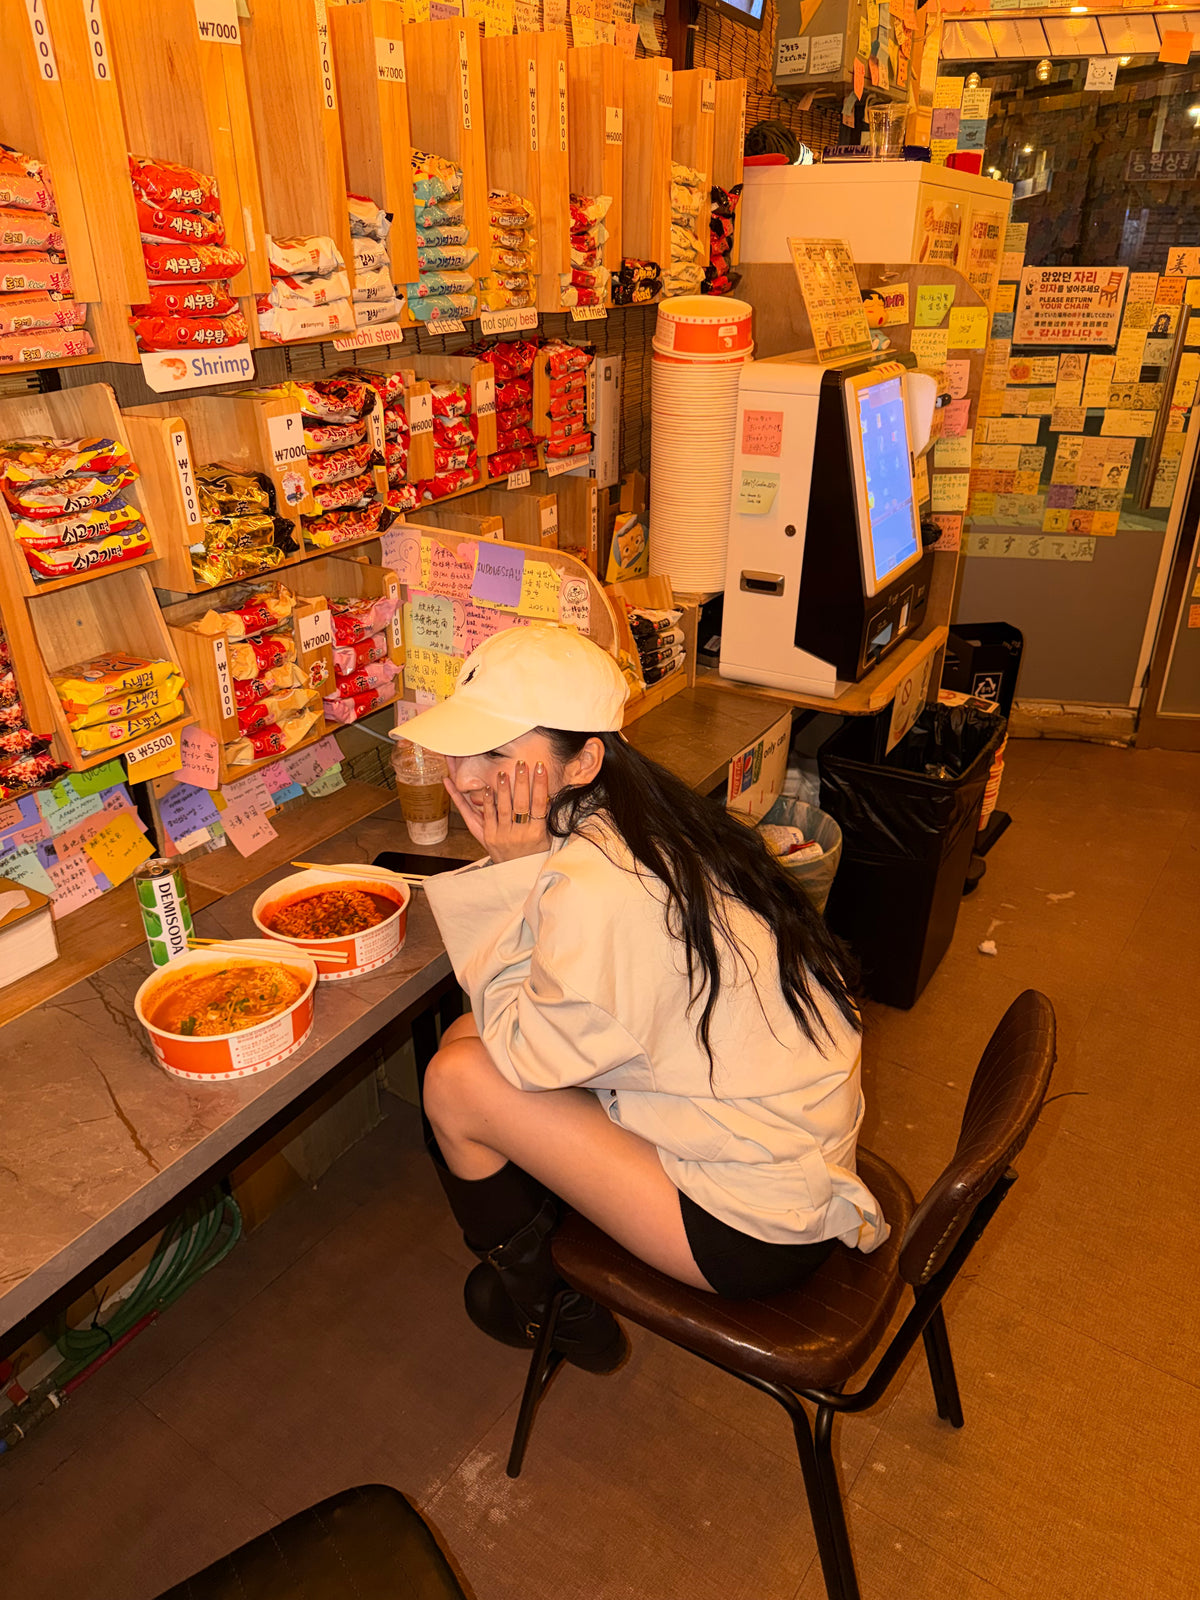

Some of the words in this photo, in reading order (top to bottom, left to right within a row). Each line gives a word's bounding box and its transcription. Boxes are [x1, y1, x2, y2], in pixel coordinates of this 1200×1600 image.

[199, 22, 238, 40] ₩7000
[389, 43, 395, 54] P
[378, 66, 404, 80] ₩7000
[168, 187, 203, 205] 새우탕
[169, 217, 204, 238] 새우탕
[165, 257, 202, 274] 새우탕
[1073, 271, 1098, 284] 자리
[183, 294, 216, 310] 새우탕
[572, 306, 587, 318] Not
[588, 305, 606, 317] fried
[428, 319, 466, 335] CHEESE
[482, 319, 495, 330] not
[497, 315, 518, 331] spicy
[519, 312, 537, 326] best
[192, 329, 226, 345] 새우탕
[375, 328, 401, 343] stew
[1039, 329, 1092, 337] 감사합니다
[192, 355, 251, 378] Shrimp
[484, 381, 490, 390] A
[421, 397, 427, 407] A
[286, 418, 293, 430] P
[411, 418, 433, 433] ₩6000
[175, 434, 182, 445] P
[275, 444, 307, 462] ₩7000
[510, 472, 530, 488] HELL
[178, 459, 197, 522] ₩7000
[61, 520, 111, 546] 쇠고기면
[72, 545, 123, 571] 쇠고기면
[391, 584, 396, 594] P
[314, 614, 320, 625] P
[217, 640, 223, 651] P
[303, 632, 330, 650] ₩7000
[217, 661, 232, 718] ₩7000
[126, 689, 160, 714] 스낵면
[127, 711, 162, 737] 스낵면
[128, 752, 137, 763] B
[137, 735, 174, 759] ₩5500
[763, 742, 777, 759] only
[776, 733, 787, 747] can
[158, 882, 185, 955] DEMISODA
